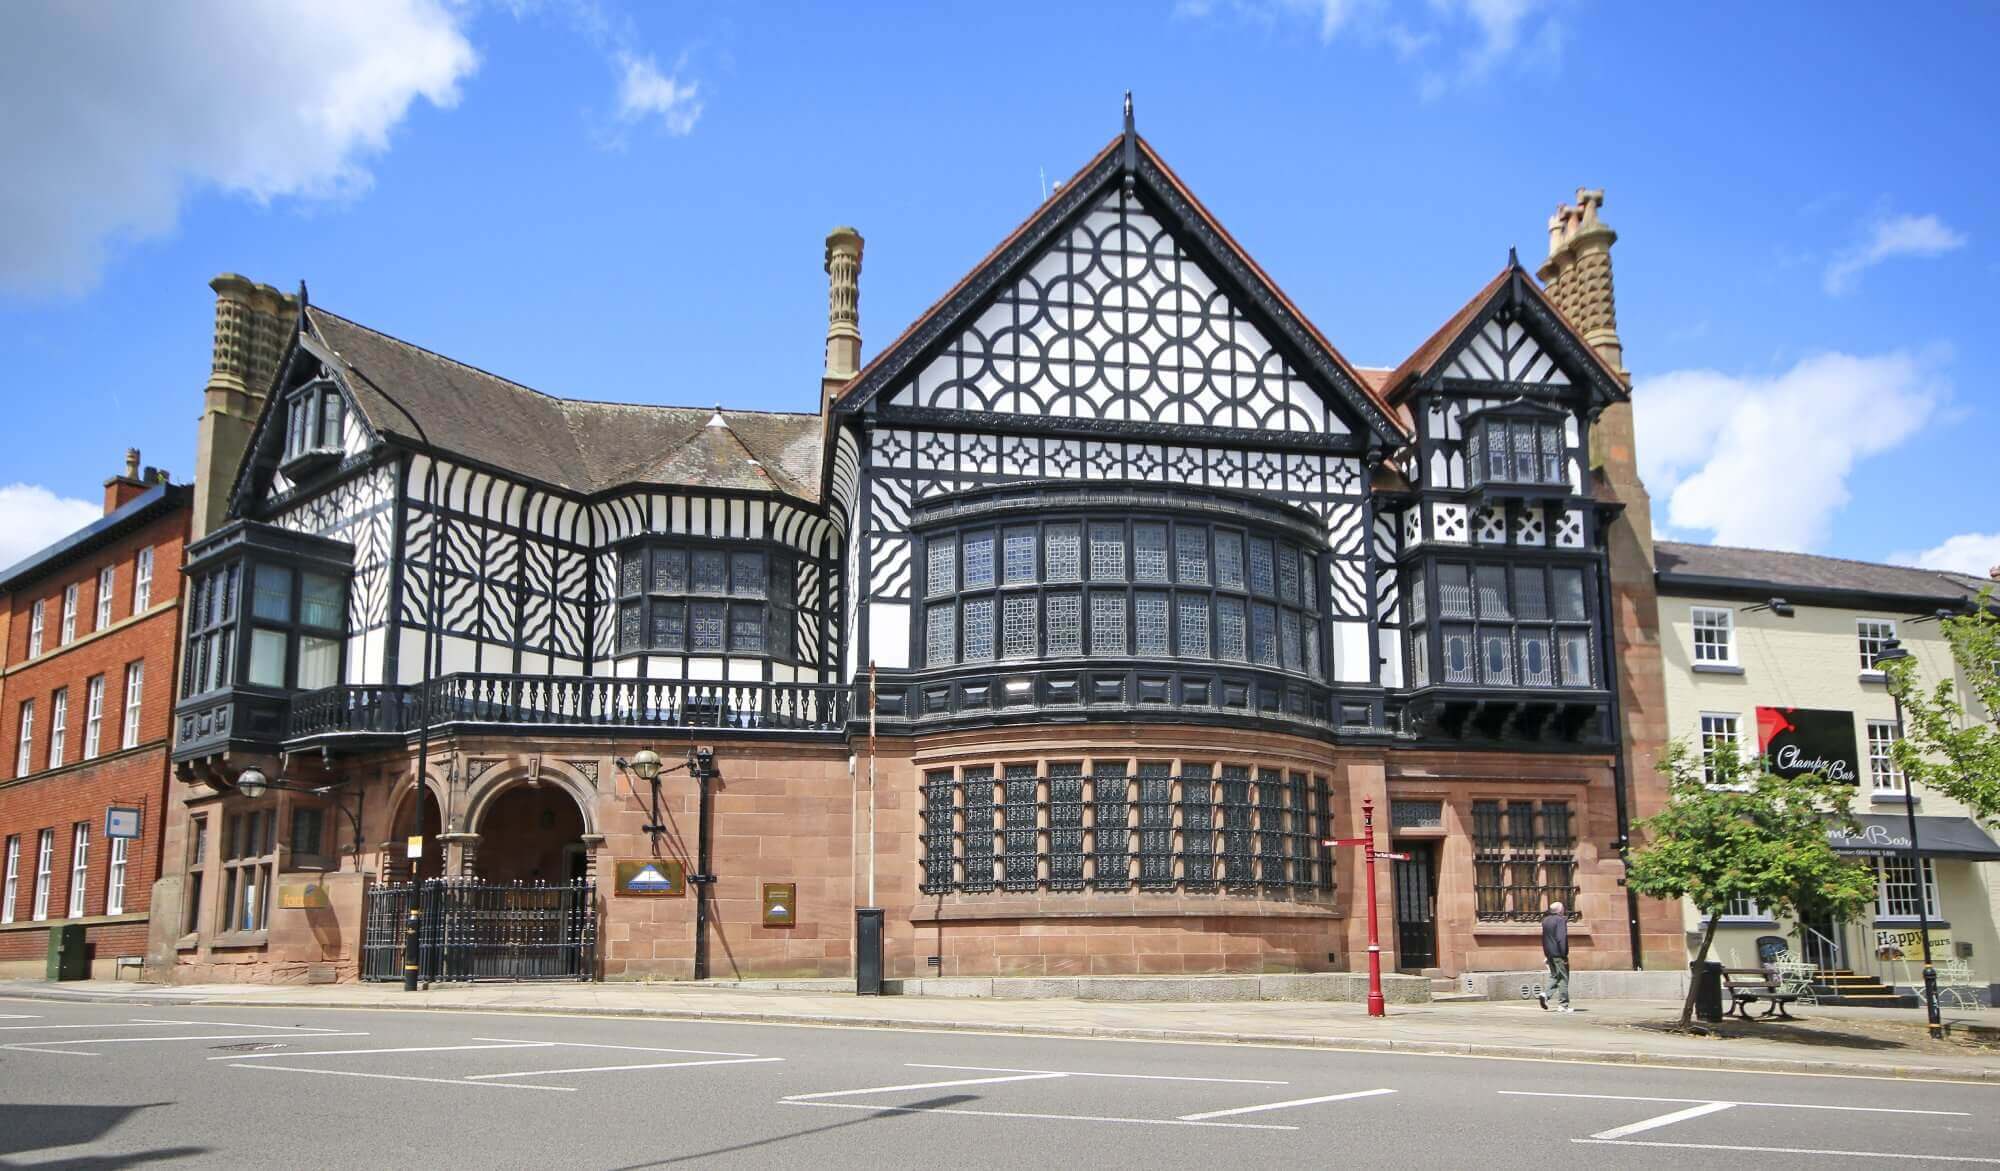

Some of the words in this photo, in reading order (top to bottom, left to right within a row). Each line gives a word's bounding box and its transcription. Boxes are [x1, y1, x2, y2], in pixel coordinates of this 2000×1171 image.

[1827, 759, 1855, 780] Bar
[1865, 825, 1912, 846] Bar
[1877, 931, 1924, 947] Happy
